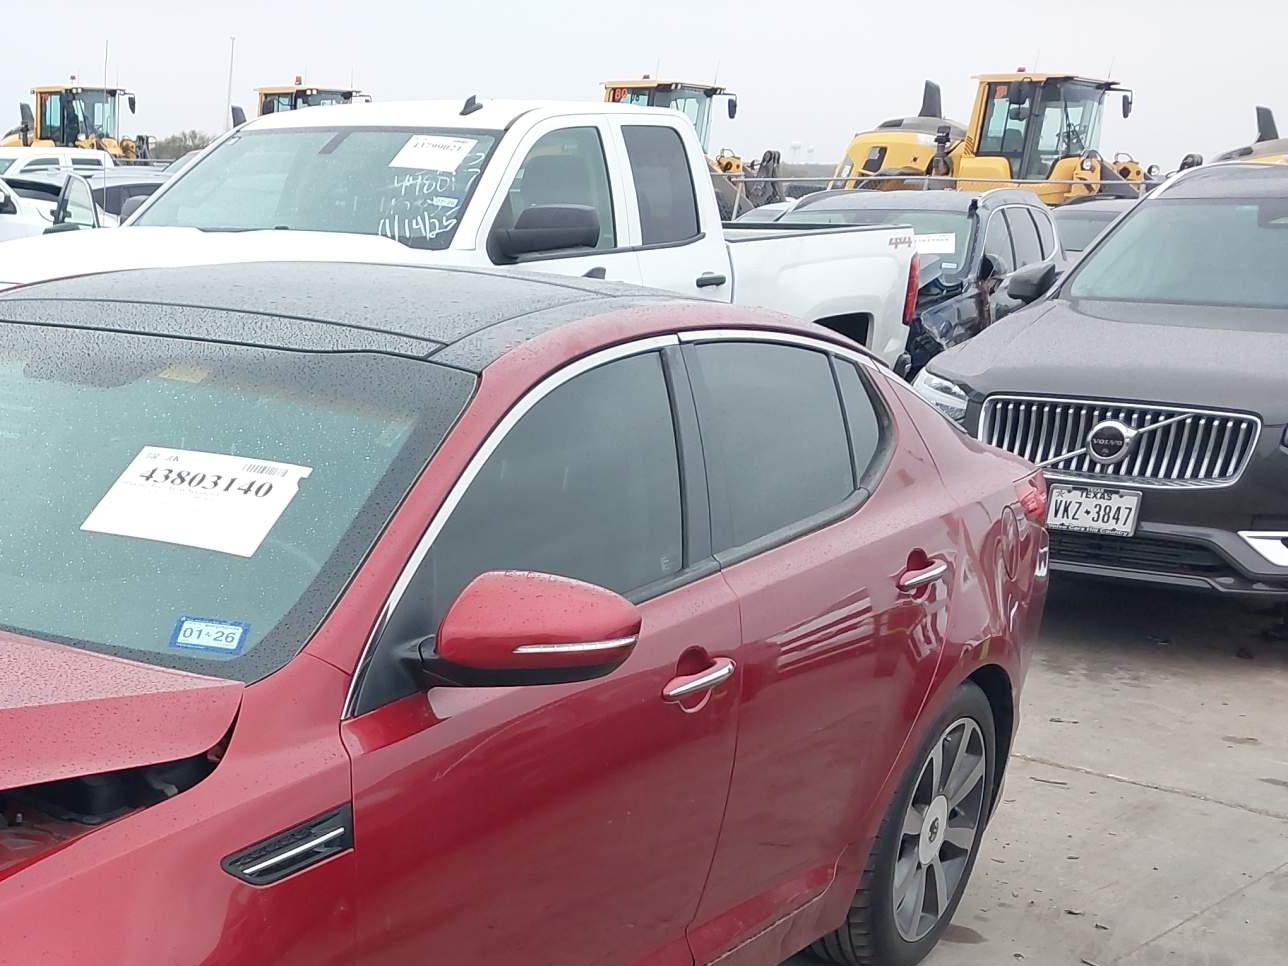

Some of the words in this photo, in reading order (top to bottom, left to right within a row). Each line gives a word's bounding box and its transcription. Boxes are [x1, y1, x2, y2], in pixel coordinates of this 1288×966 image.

[1092, 438, 1123, 446] VOLVO
[139, 465, 274, 498] 43803140
[1079, 489, 1113, 501] TEXAS
[1053, 499, 1083, 521] VKZ
[1091, 503, 1133, 526] 3847
